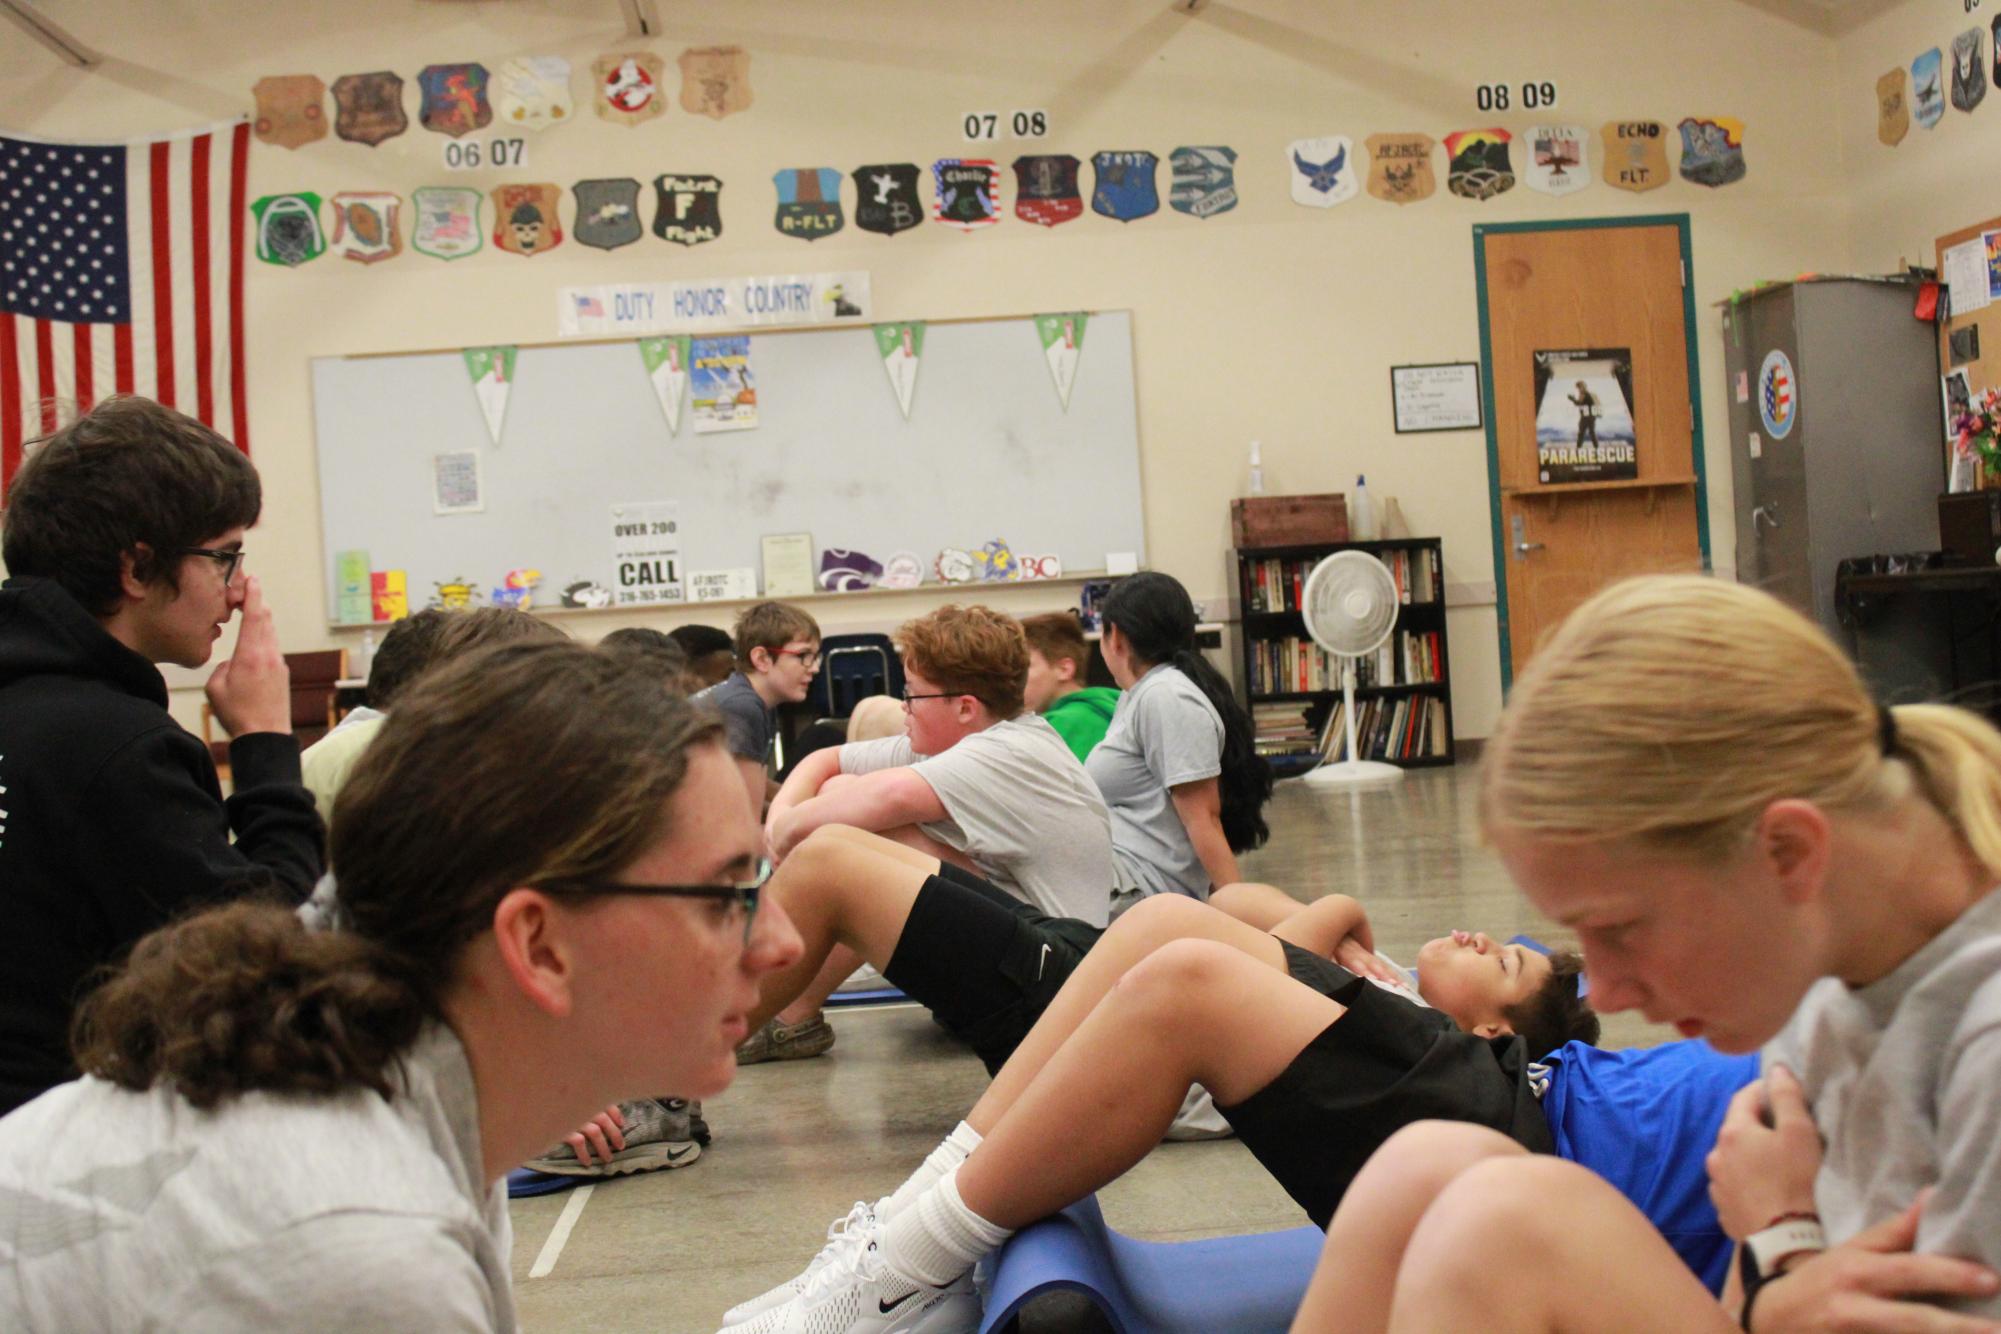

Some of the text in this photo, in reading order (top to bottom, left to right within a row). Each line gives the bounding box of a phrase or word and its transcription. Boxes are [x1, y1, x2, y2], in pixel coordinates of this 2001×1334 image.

[1476, 82, 1555, 111] 08 09
[965, 112, 1046, 139] 07 08
[1617, 121, 1660, 139] ECHO
[446, 139, 524, 168] 06 07
[675, 193, 696, 220] F
[615, 283, 814, 322] DUTY HONOR COUNTRY
[1539, 446, 1636, 466] PARARESCUE
[615, 521, 677, 537] OVER 200
[619, 560, 679, 587] CALL
[1020, 556, 1057, 580] BC
